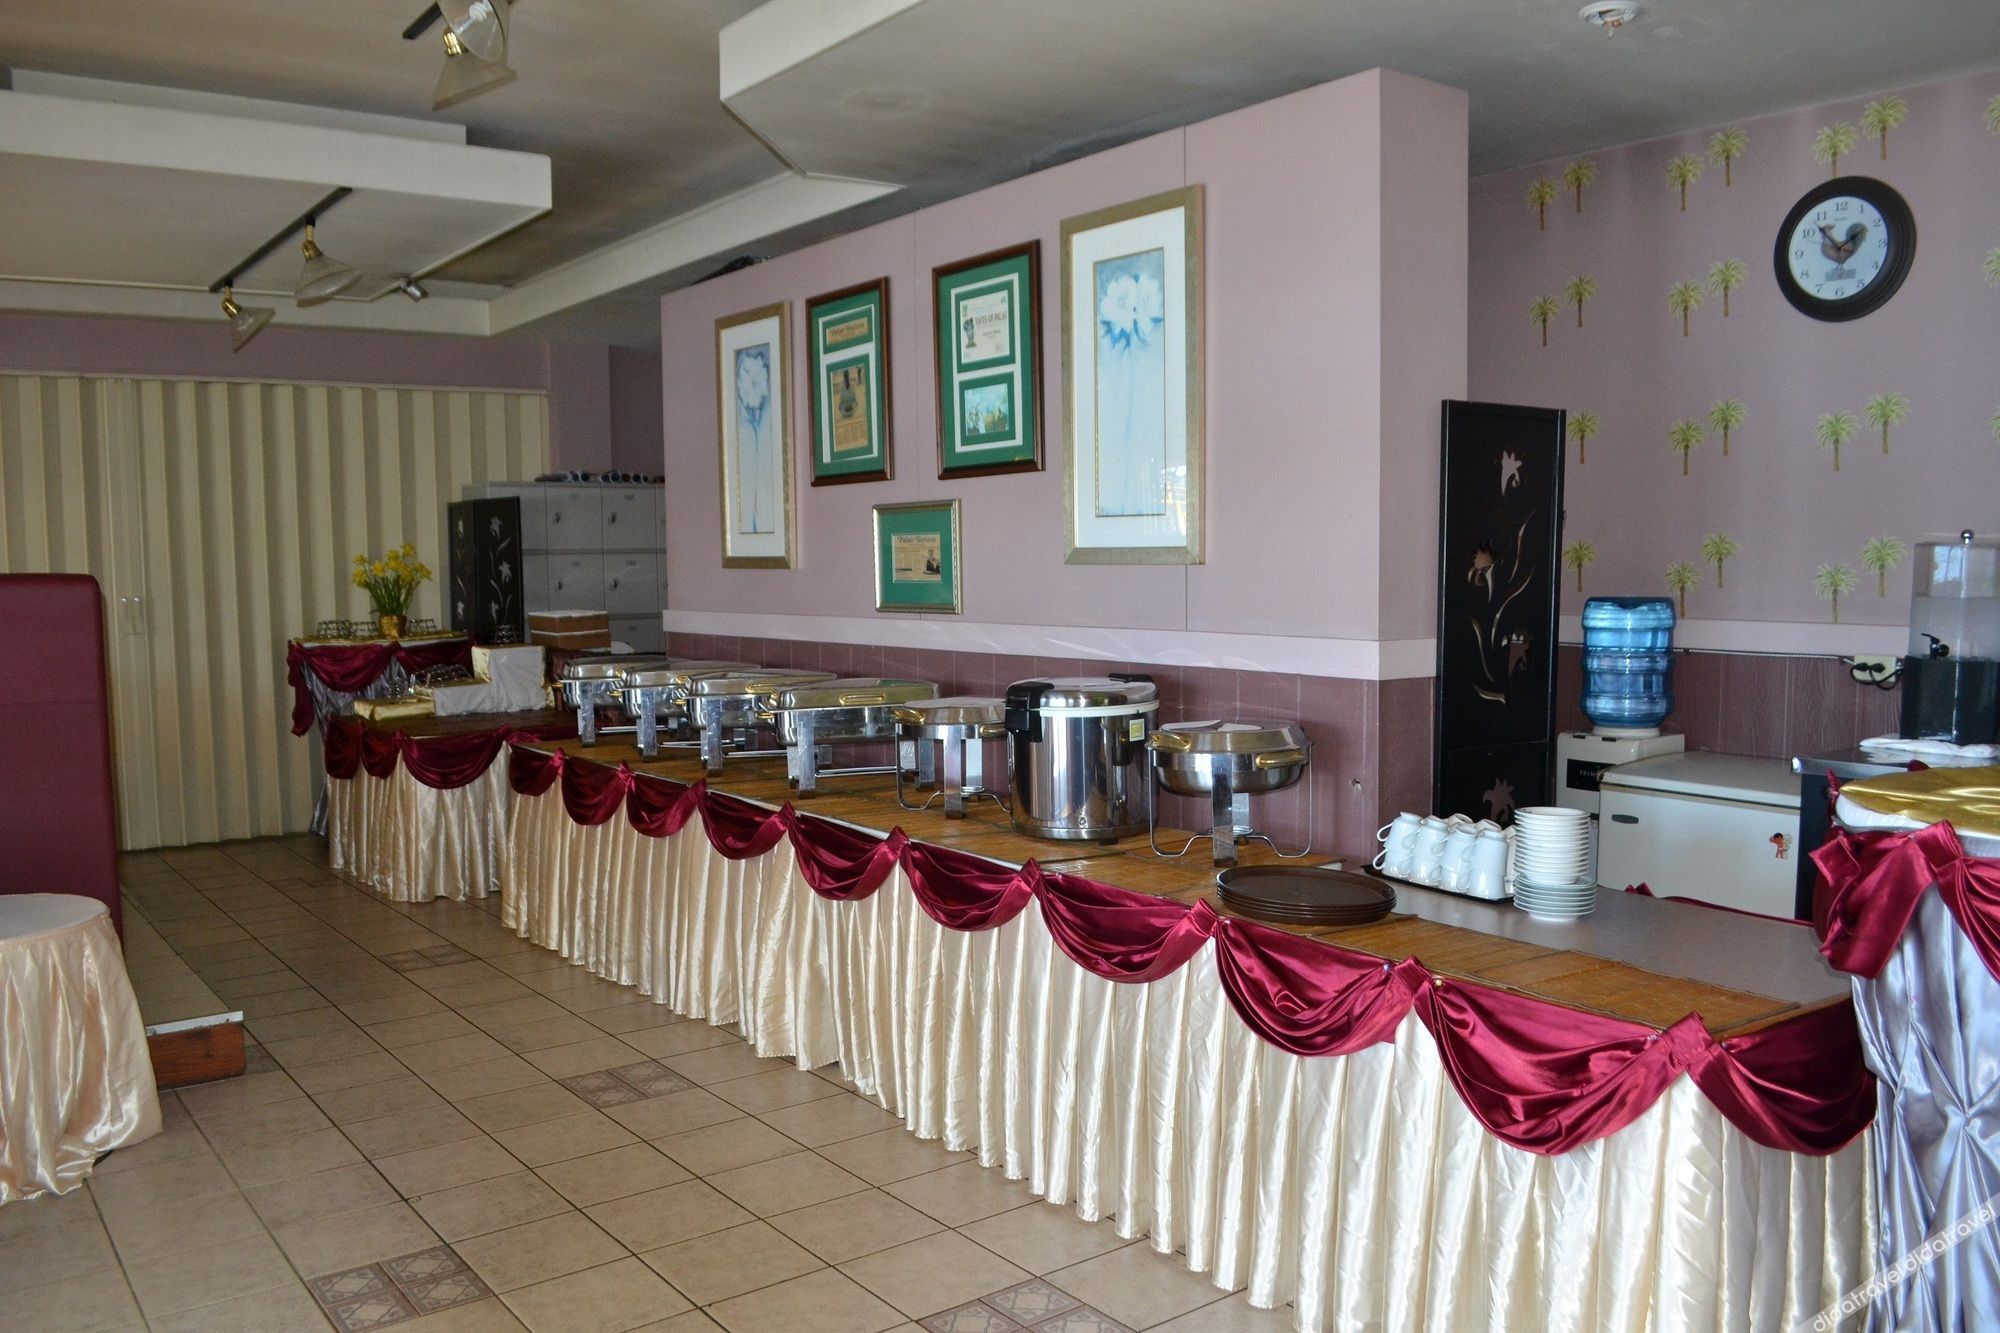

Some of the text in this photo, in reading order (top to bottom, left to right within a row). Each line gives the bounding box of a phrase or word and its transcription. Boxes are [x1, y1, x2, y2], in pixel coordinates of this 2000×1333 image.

[1835, 201, 1848, 212] 12
[1816, 211, 1827, 221] 11
[1872, 218, 1881, 228] 2
[1802, 228, 1816, 239] 10
[1878, 239, 1887, 249] 3
[1794, 249, 1804, 259] 9
[1871, 261, 1879, 271] 4
[1800, 270, 1809, 279] 8
[1815, 283, 1824, 294] 7
[1856, 278, 1865, 289] 5
[1834, 287, 1845, 297] 6
